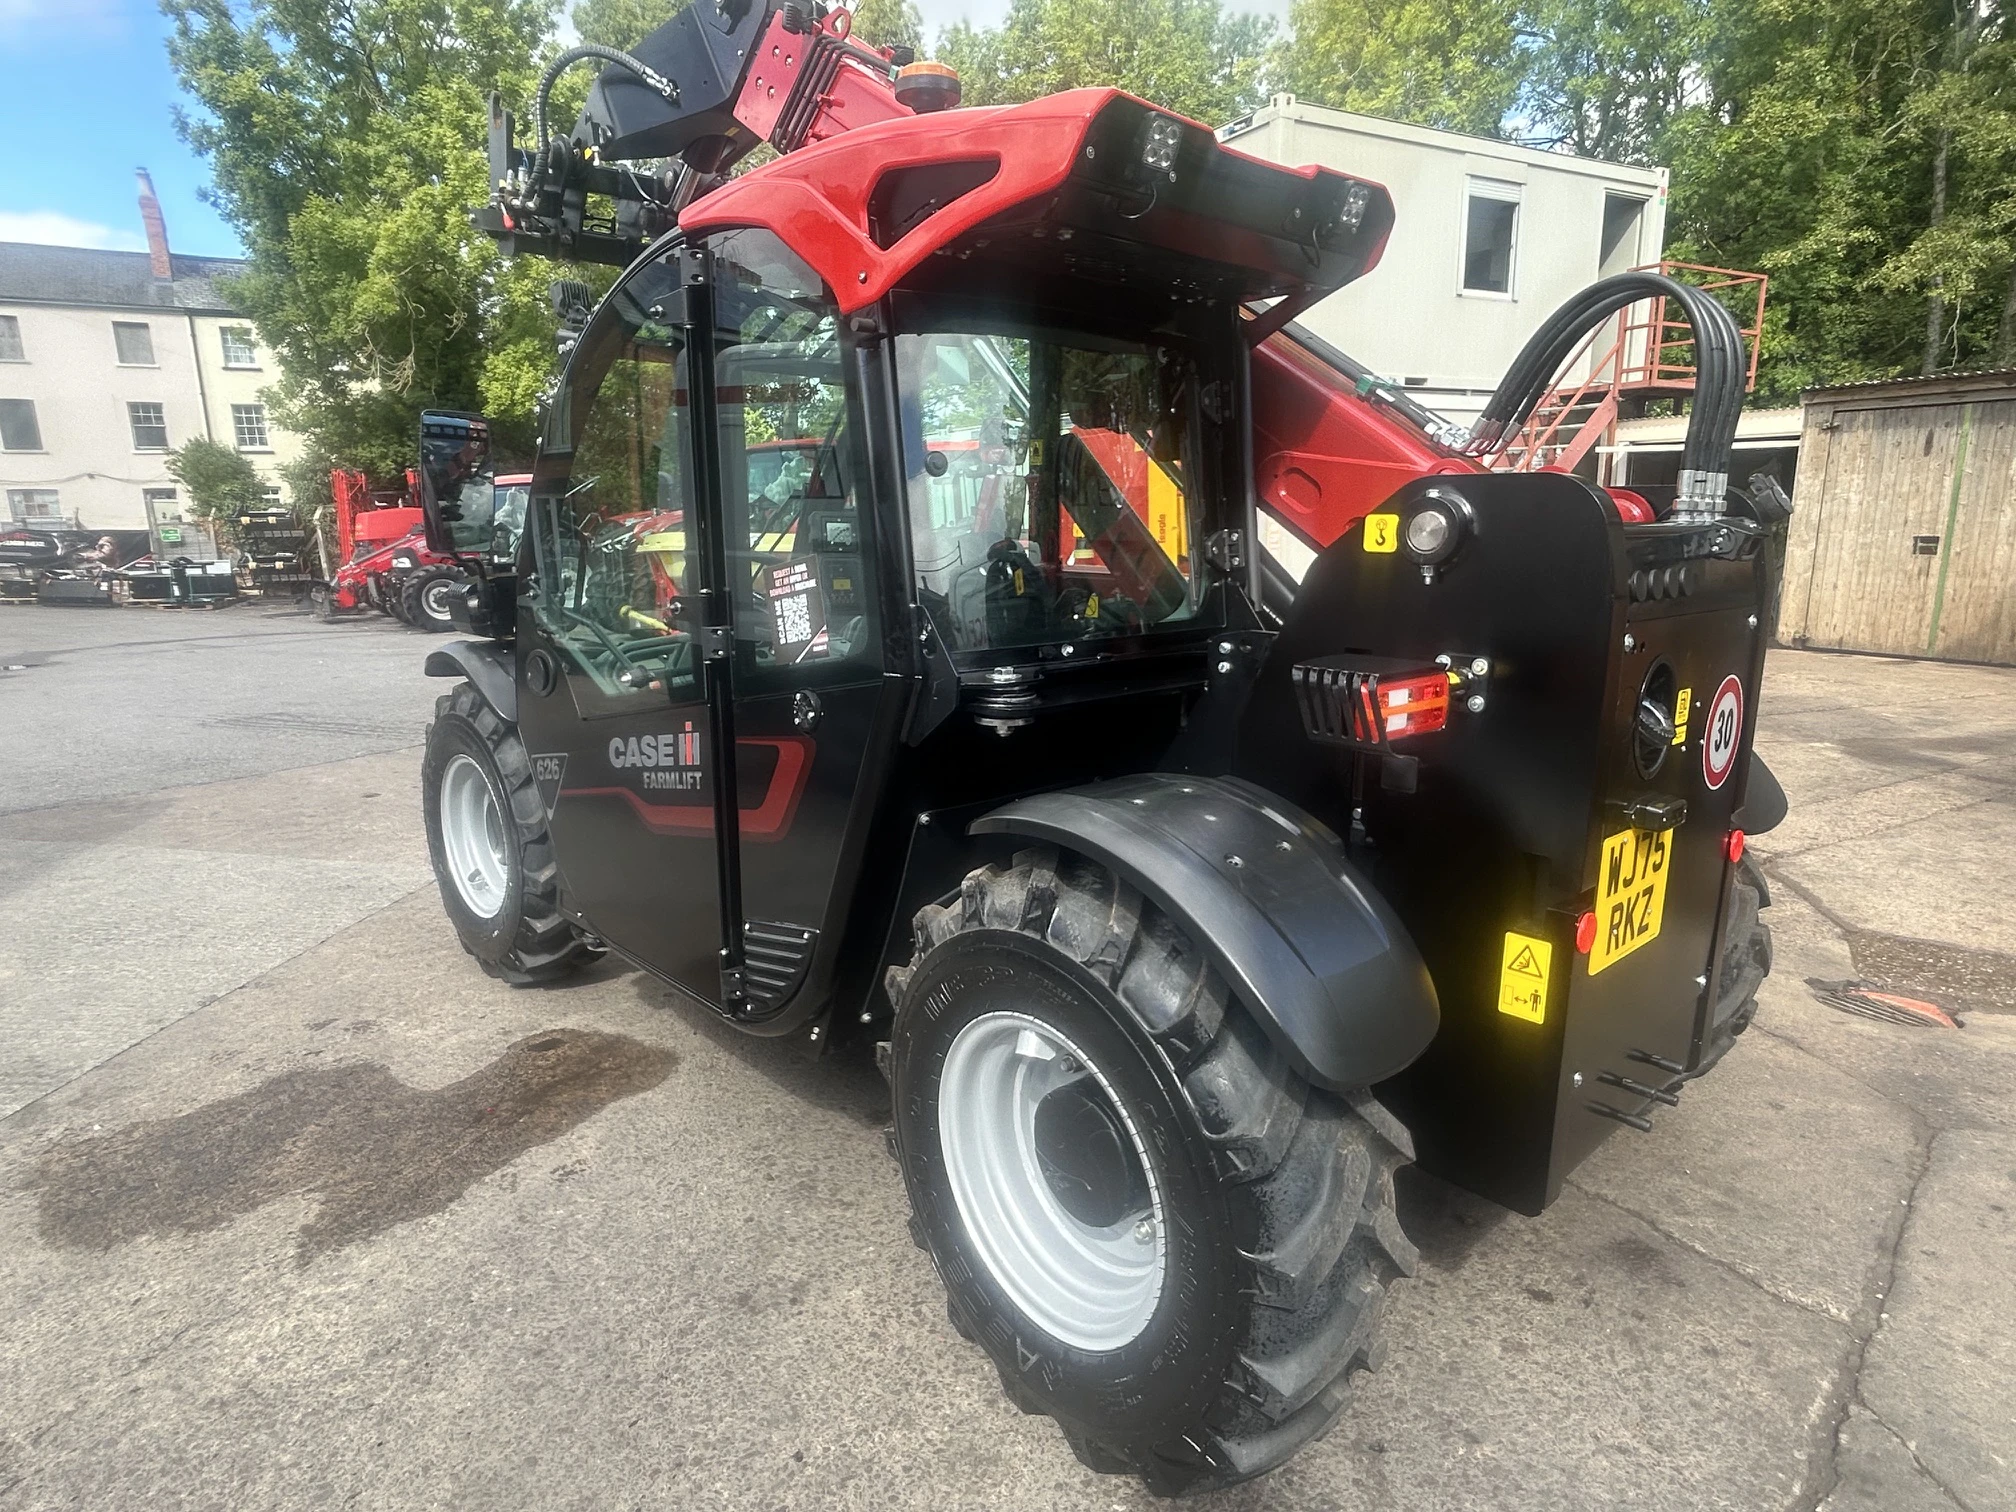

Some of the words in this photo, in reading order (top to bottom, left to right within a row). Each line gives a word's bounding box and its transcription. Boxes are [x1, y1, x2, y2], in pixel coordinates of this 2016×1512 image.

[1714, 708, 1734, 753] 30
[536, 758, 560, 780] 626
[608, 734, 675, 768] CASE
[642, 771, 703, 790] FARMLIFT
[1606, 830, 1666, 899] WJ75
[1605, 883, 1655, 956] RKZ
